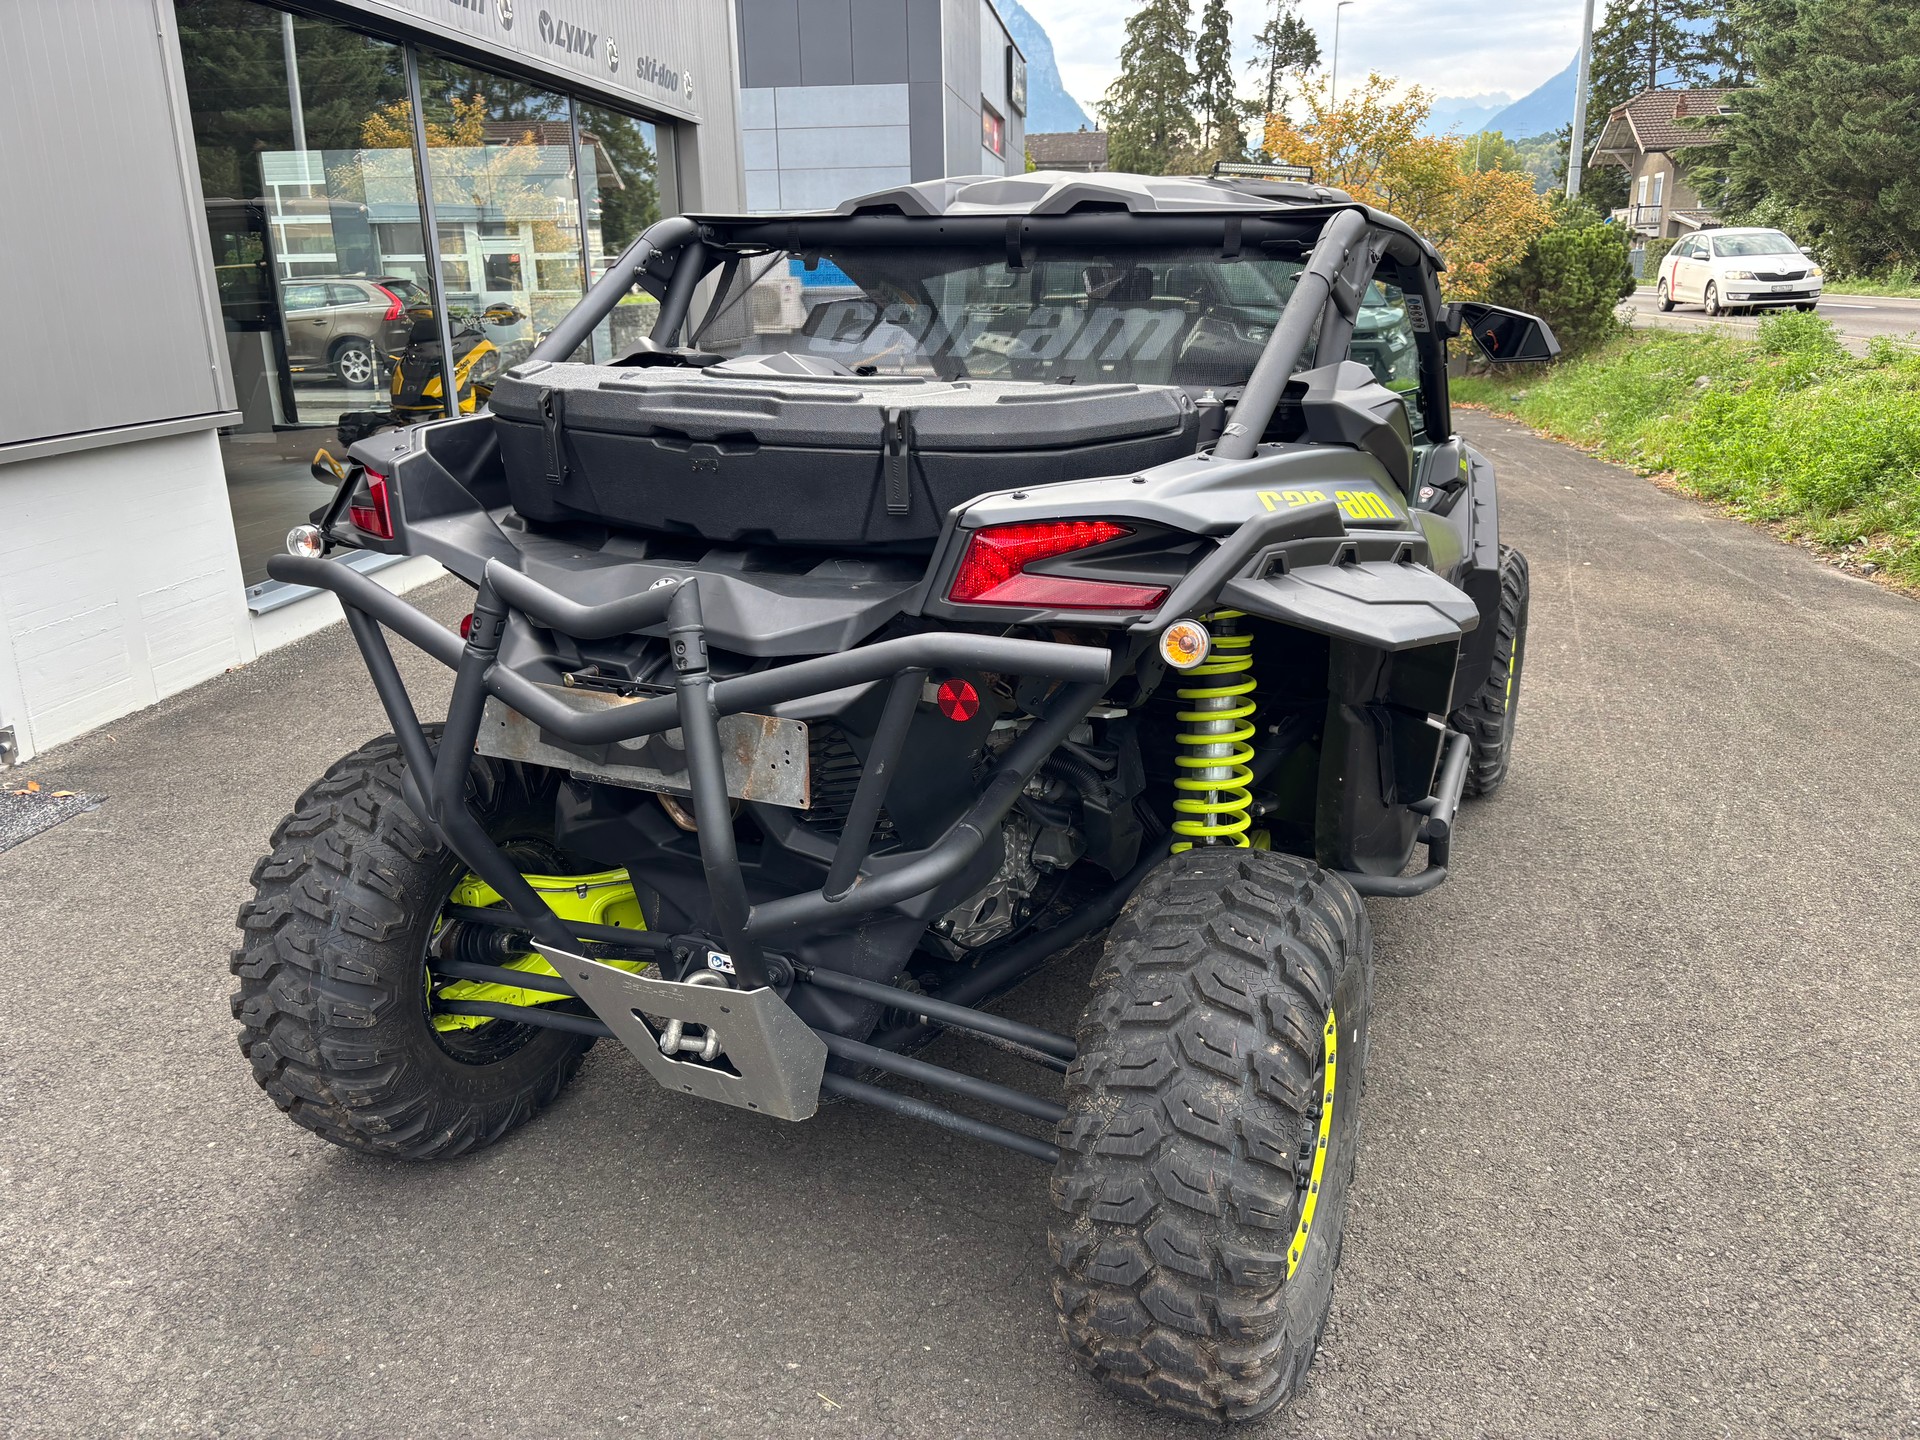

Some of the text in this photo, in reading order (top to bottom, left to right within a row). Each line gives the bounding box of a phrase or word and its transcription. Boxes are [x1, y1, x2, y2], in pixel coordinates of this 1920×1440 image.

[555, 19, 598, 59] LYNX
[636, 55, 679, 92] ski-doo
[807, 302, 1187, 361] can-am
[1256, 490, 1396, 519] caam
